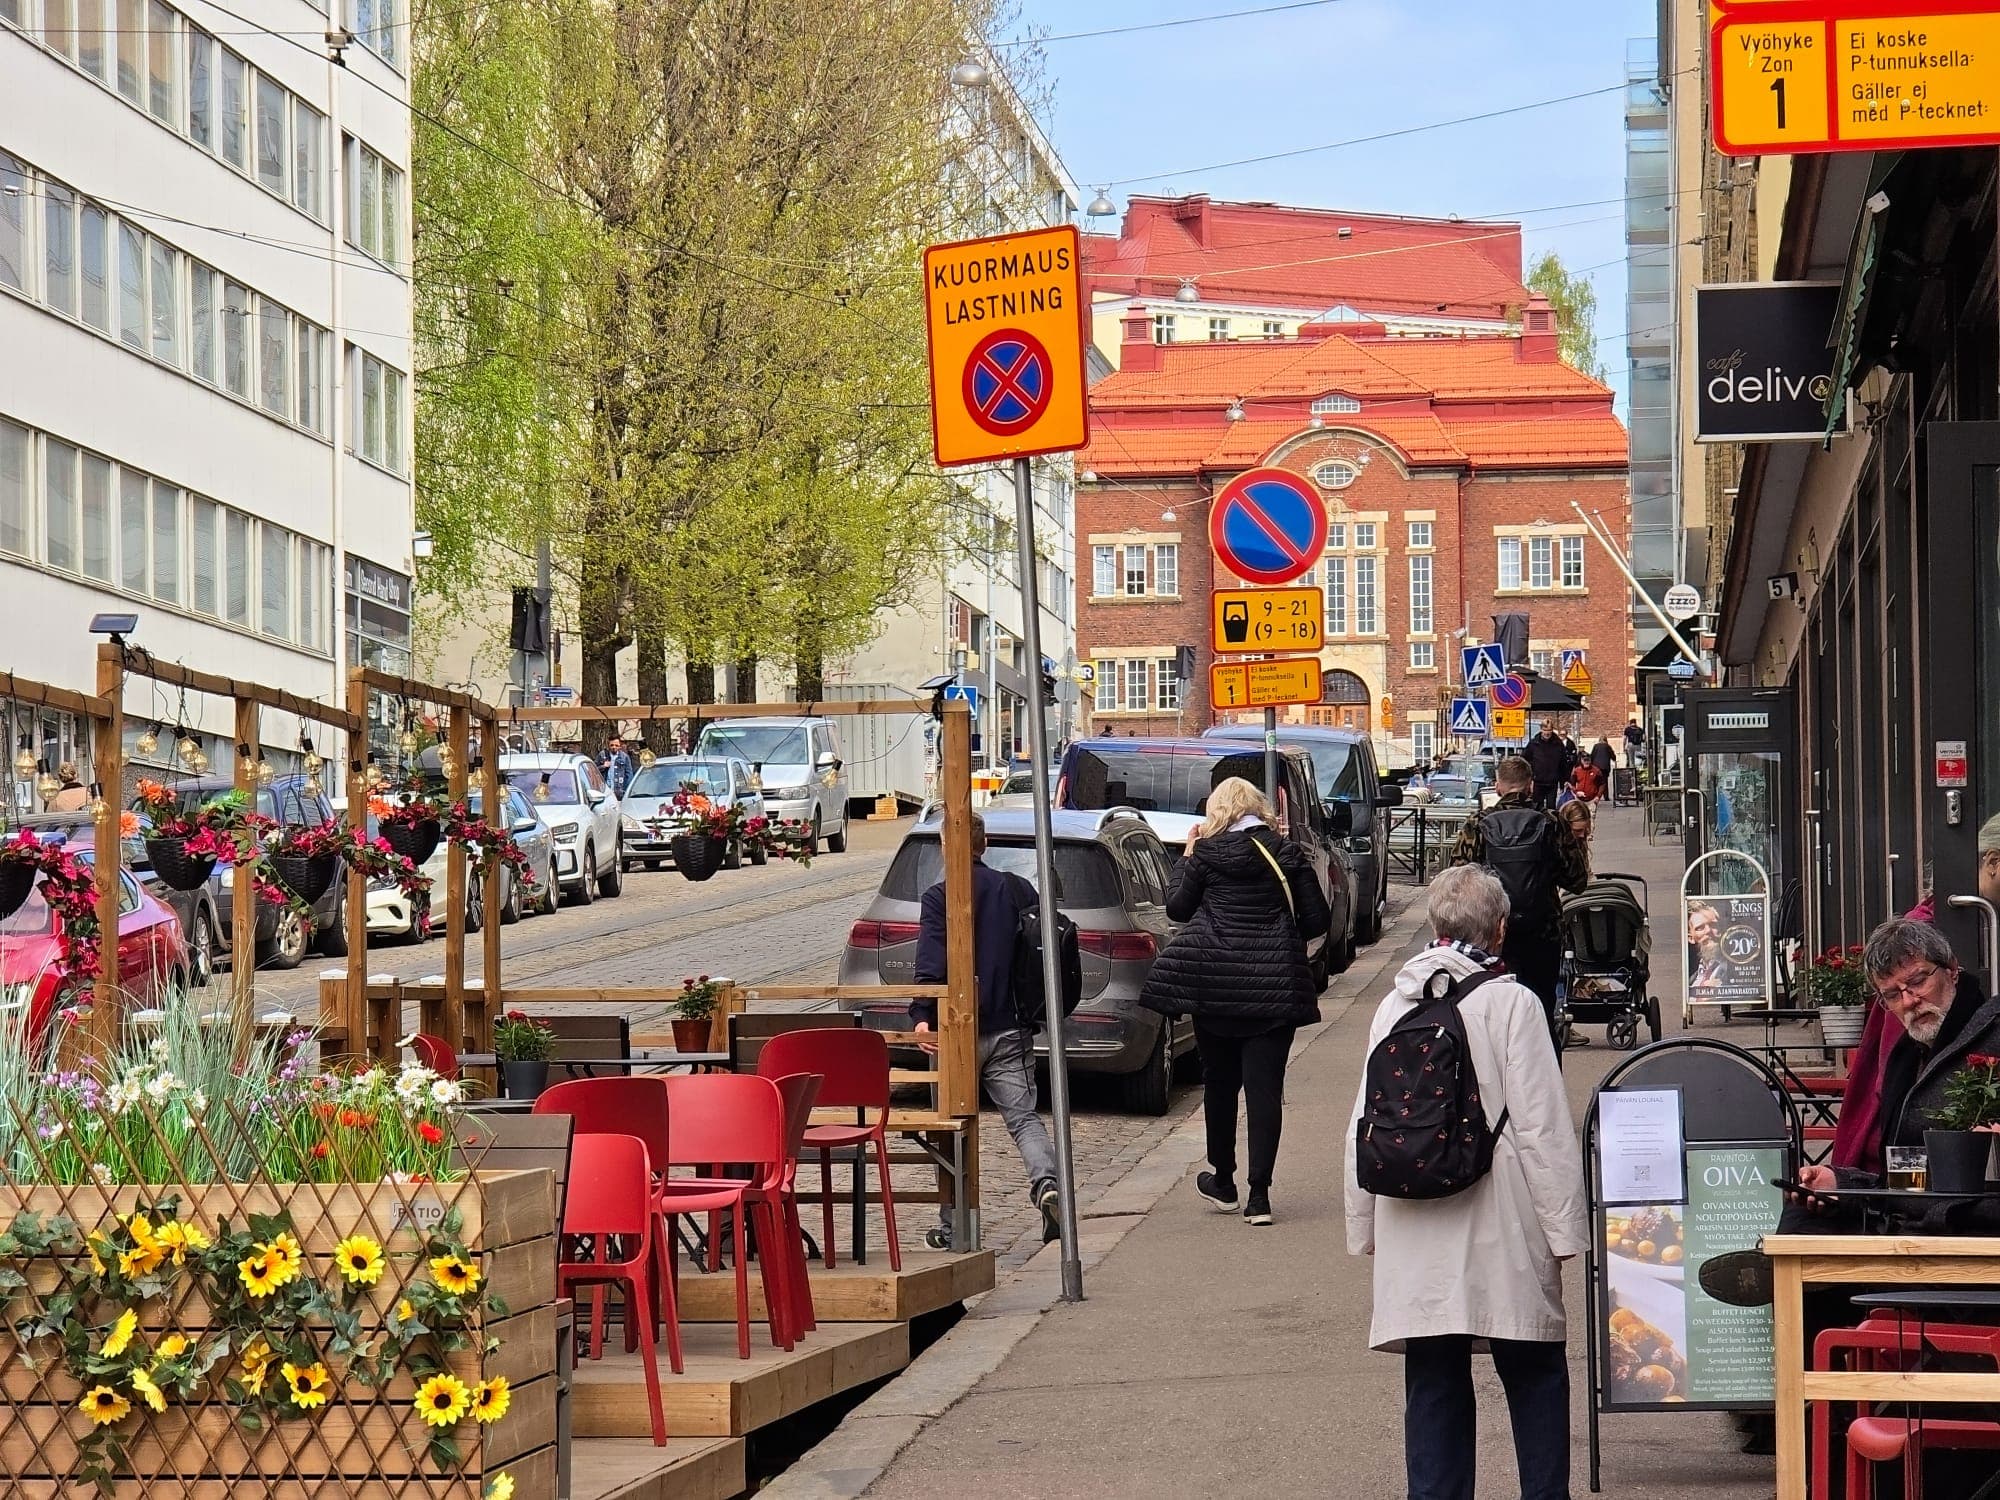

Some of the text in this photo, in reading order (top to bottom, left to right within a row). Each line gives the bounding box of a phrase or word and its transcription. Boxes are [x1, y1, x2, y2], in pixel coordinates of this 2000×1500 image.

[1740, 33, 1813, 52] Vyöhyke
[1850, 31, 1928, 49] Ei koske
[1761, 56, 1793, 73] Zon
[1850, 51, 1976, 72] P-tunnuksella:
[1851, 80, 1928, 100] Gäller ej
[1770, 78, 1786, 129] 1
[1852, 104, 1889, 122] med
[934, 247, 1070, 289] KUORMAUS
[945, 286, 1063, 325] LASTNING
[1706, 348, 1748, 377] café
[388, 576, 400, 607] Shop
[1772, 580, 1783, 597] 5
[1227, 685, 1235, 705] 1
[1731, 903, 1763, 914] KINGS
[1710, 1154, 1756, 1162] RAVINTOLA
[1703, 1165, 1765, 1187] OIVA
[398, 1207, 441, 1218] PTIO
[1702, 1200, 1769, 1210] OIVAN LOUNAS
